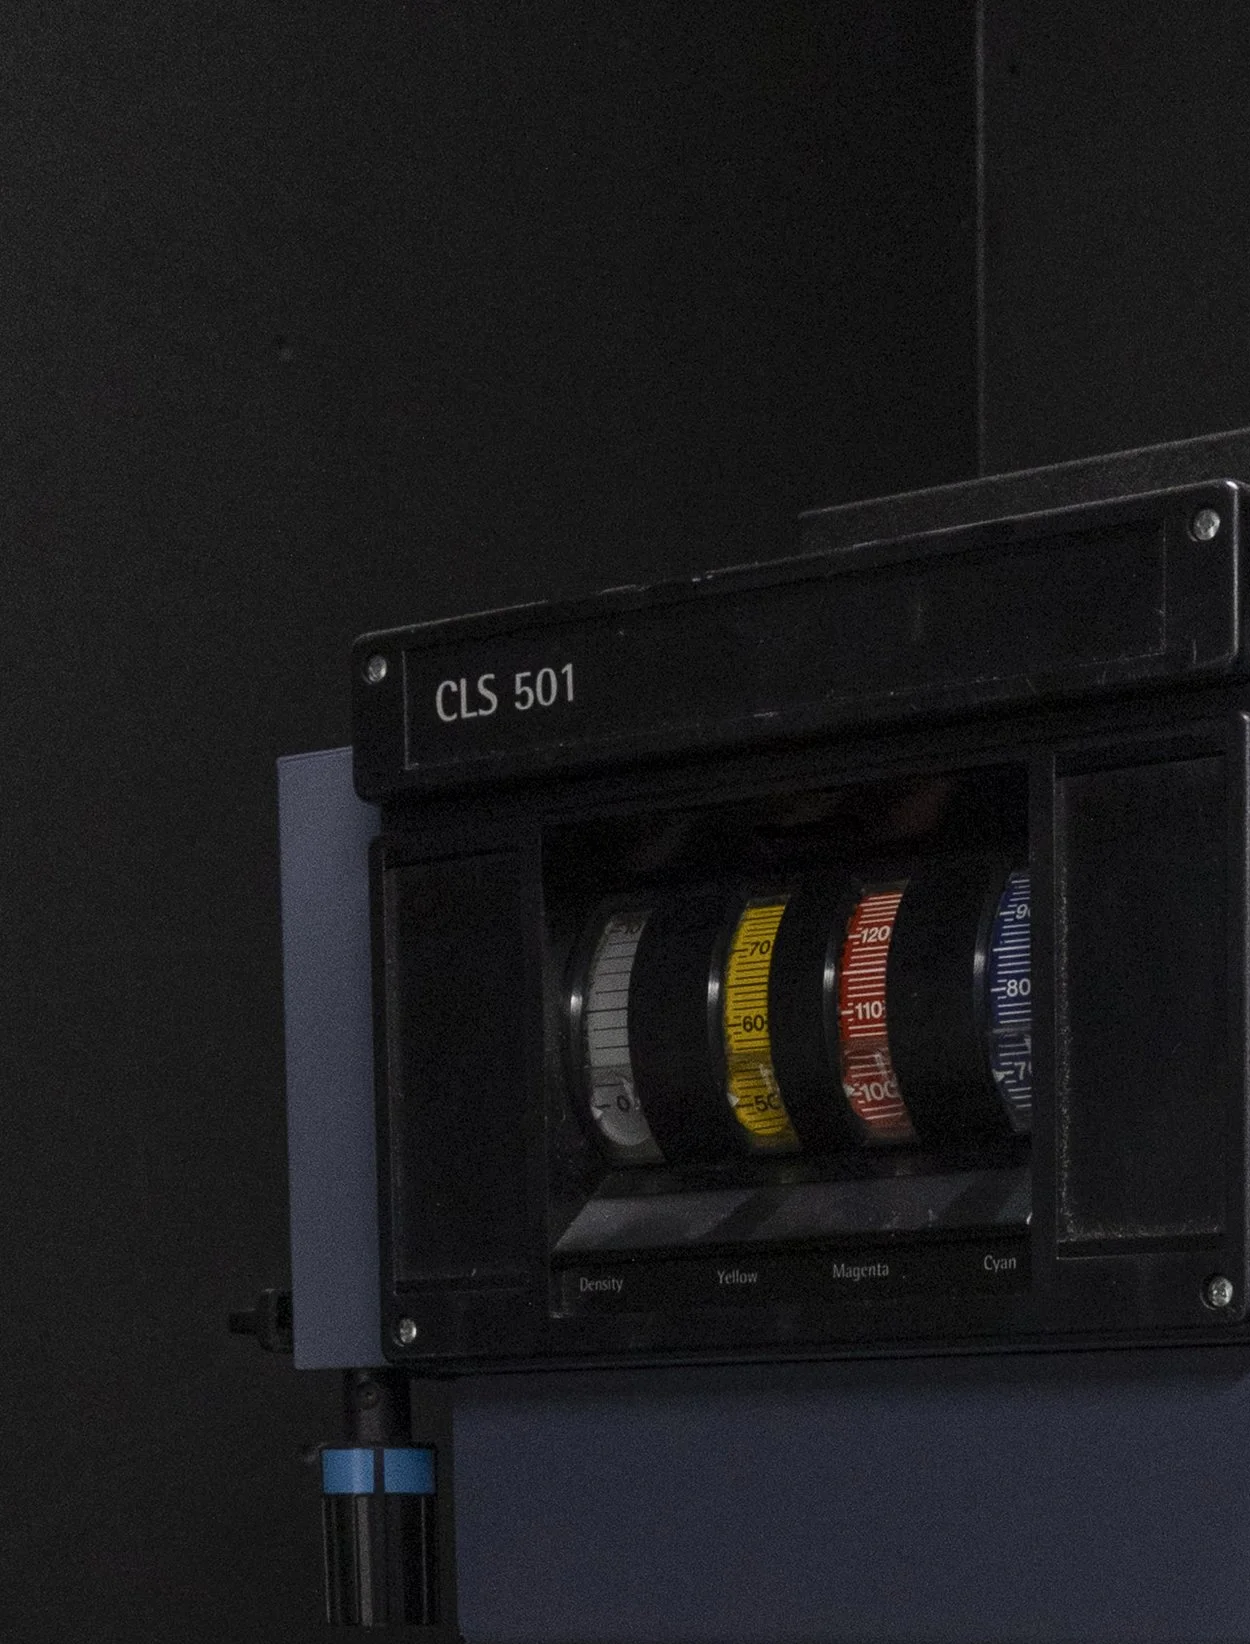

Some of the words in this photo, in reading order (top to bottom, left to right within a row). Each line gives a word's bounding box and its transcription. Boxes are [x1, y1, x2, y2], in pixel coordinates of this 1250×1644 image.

[435, 673, 499, 722] CLS
[514, 663, 575, 711] 501
[1015, 904, 1031, 920] 9
[860, 926, 891, 945] 120
[750, 940, 771, 956] 70
[1006, 979, 1031, 997] 80
[855, 1003, 883, 1020] 110
[742, 1015, 765, 1032] 60
[1014, 1063, 1032, 1081] 7
[616, 1095, 630, 1112] 0
[984, 1254, 1016, 1272] Cyan
[717, 1269, 758, 1285] Yellow
[833, 1263, 889, 1281] Magenta
[579, 1276, 624, 1293] Density
